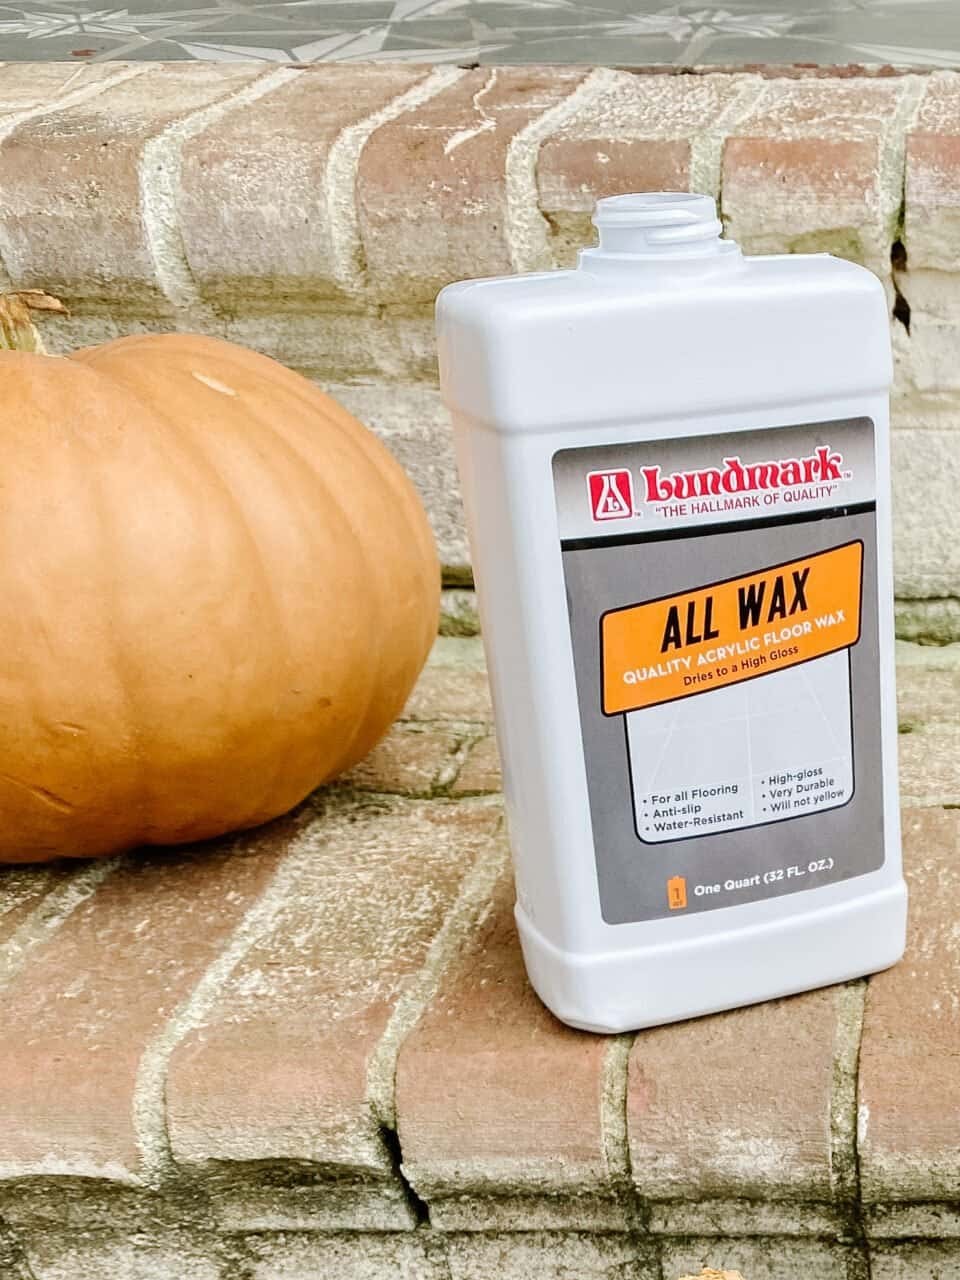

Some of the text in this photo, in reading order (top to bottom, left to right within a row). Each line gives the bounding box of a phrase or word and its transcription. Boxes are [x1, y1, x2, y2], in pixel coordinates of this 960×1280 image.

[643, 448, 842, 502] Lundmark
[691, 496, 760, 515] HALLMARK
[763, 492, 780, 506] OF
[660, 567, 811, 653] ALL WAX
[623, 609, 846, 685] QUALITY ACRYLIC FLOOR WAX
[683, 645, 799, 687] Dries to a High Gloss
[768, 767, 823, 786] High-gloss
[651, 783, 739, 806] For all Flooring
[769, 777, 835, 800] Very Durable
[652, 804, 702, 820] Anti-slip
[770, 789, 845, 813] Will not yellow
[653, 810, 744, 833] Water-Resistant
[694, 858, 834, 897] One Quart (32 FL. OZ.)
